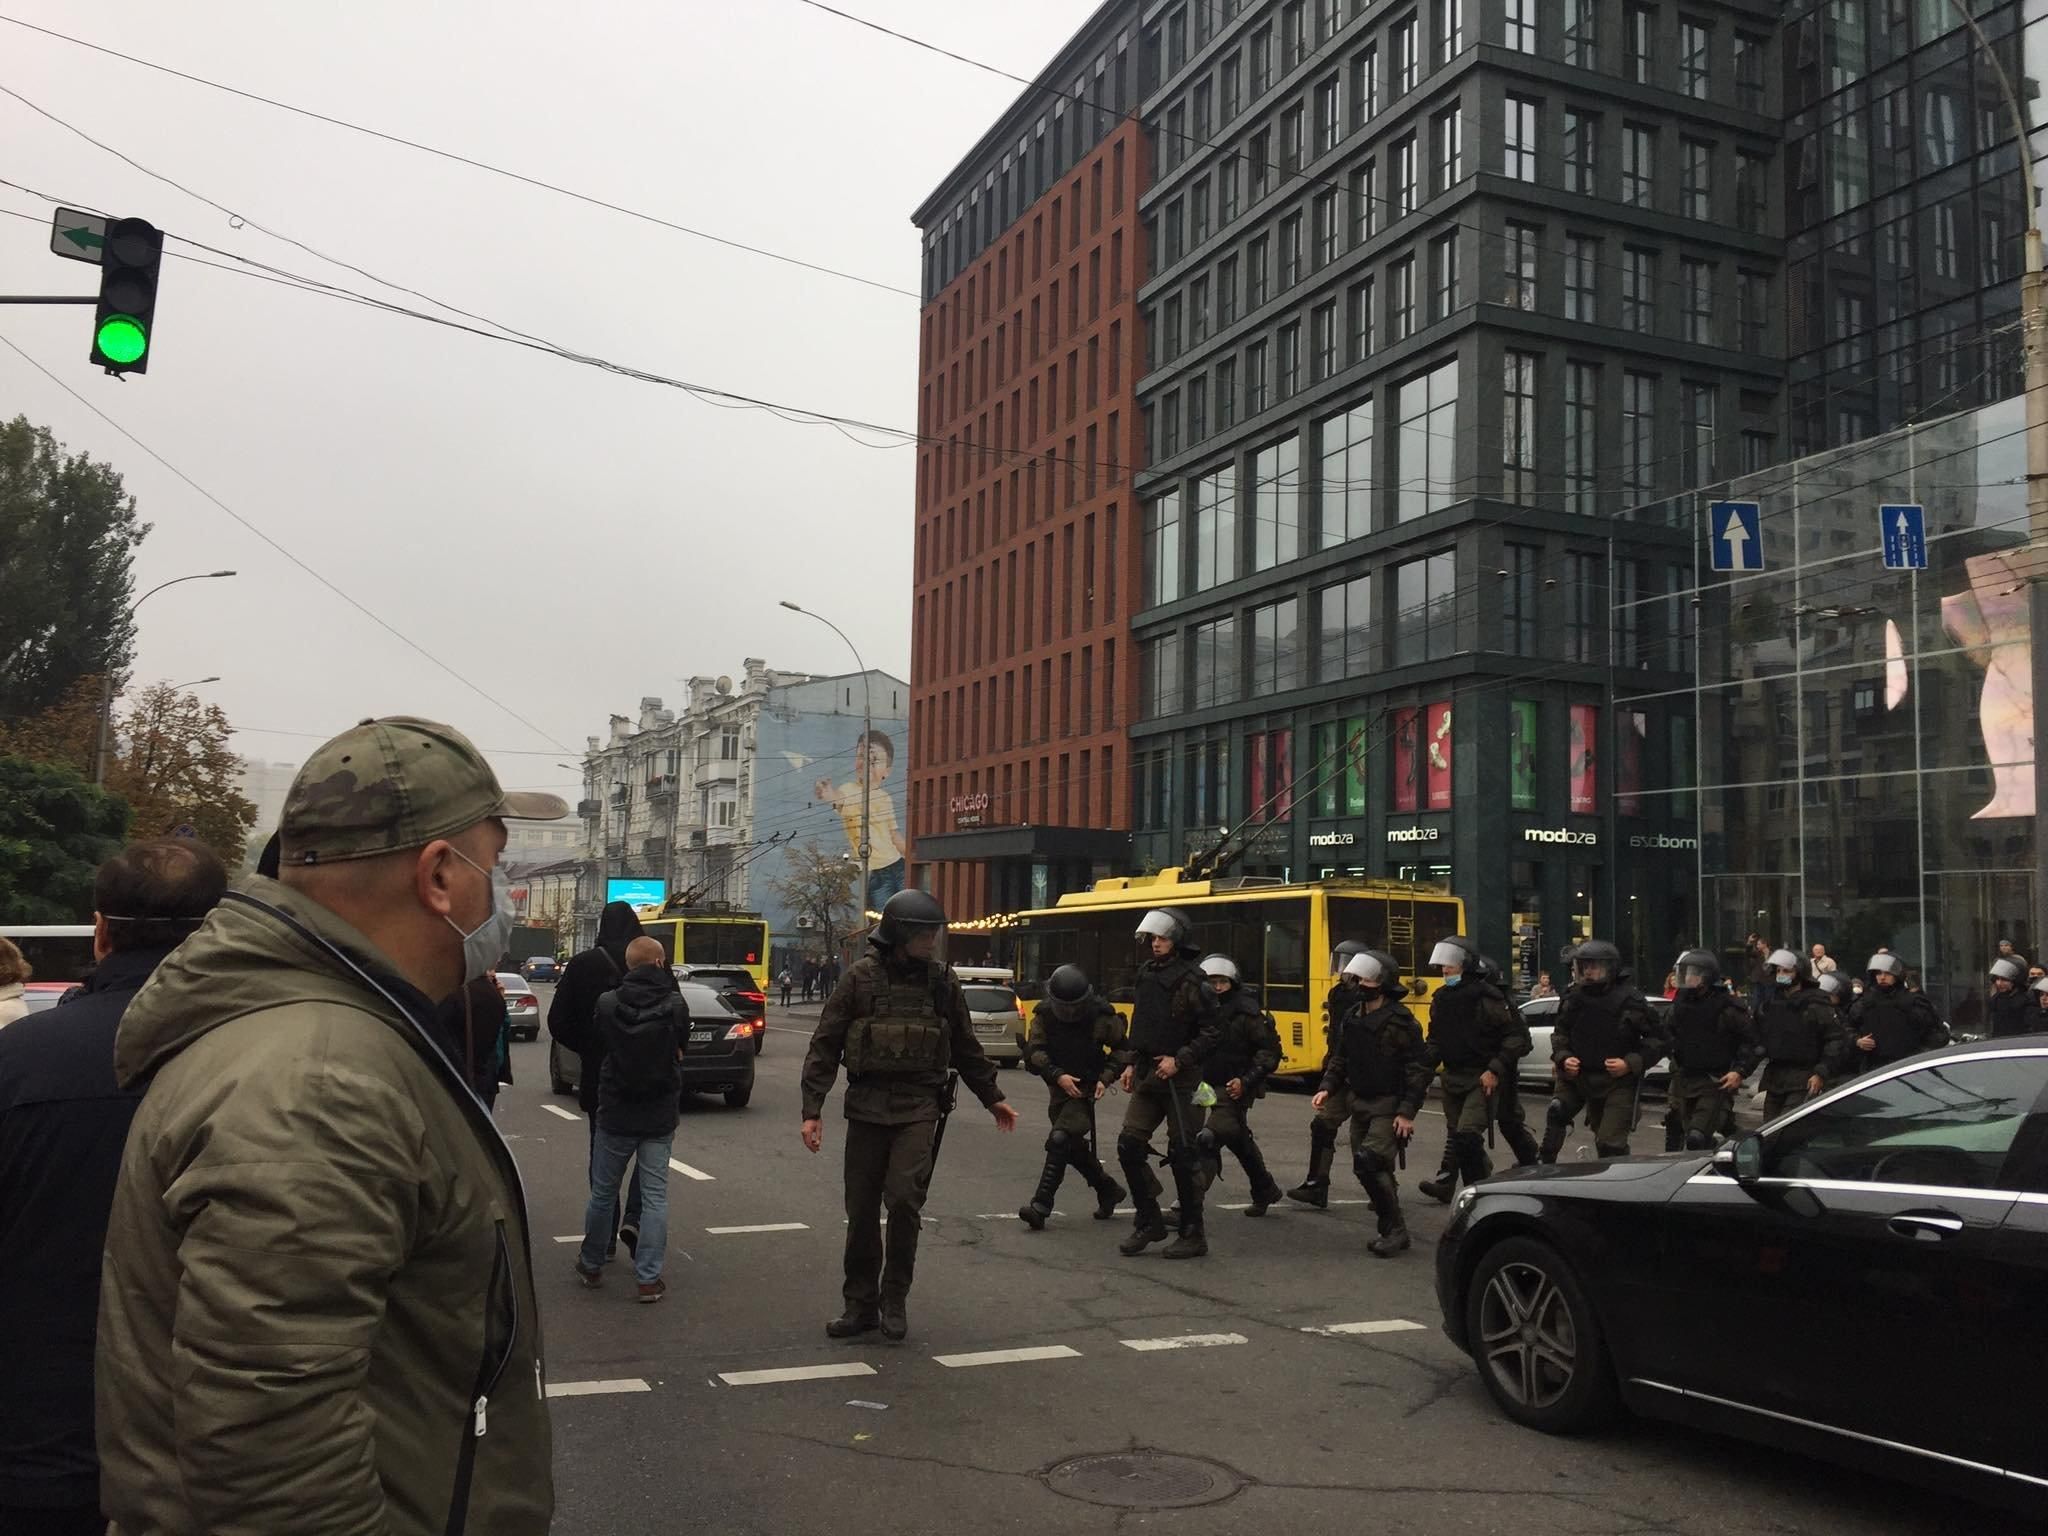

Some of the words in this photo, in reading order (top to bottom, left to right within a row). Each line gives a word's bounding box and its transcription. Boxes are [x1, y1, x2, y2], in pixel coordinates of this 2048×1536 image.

[951, 793, 988, 812] CHICAGO
[1310, 831, 1353, 845] modoza
[1387, 826, 1438, 841] modoza
[1525, 828, 1596, 844] modoza
